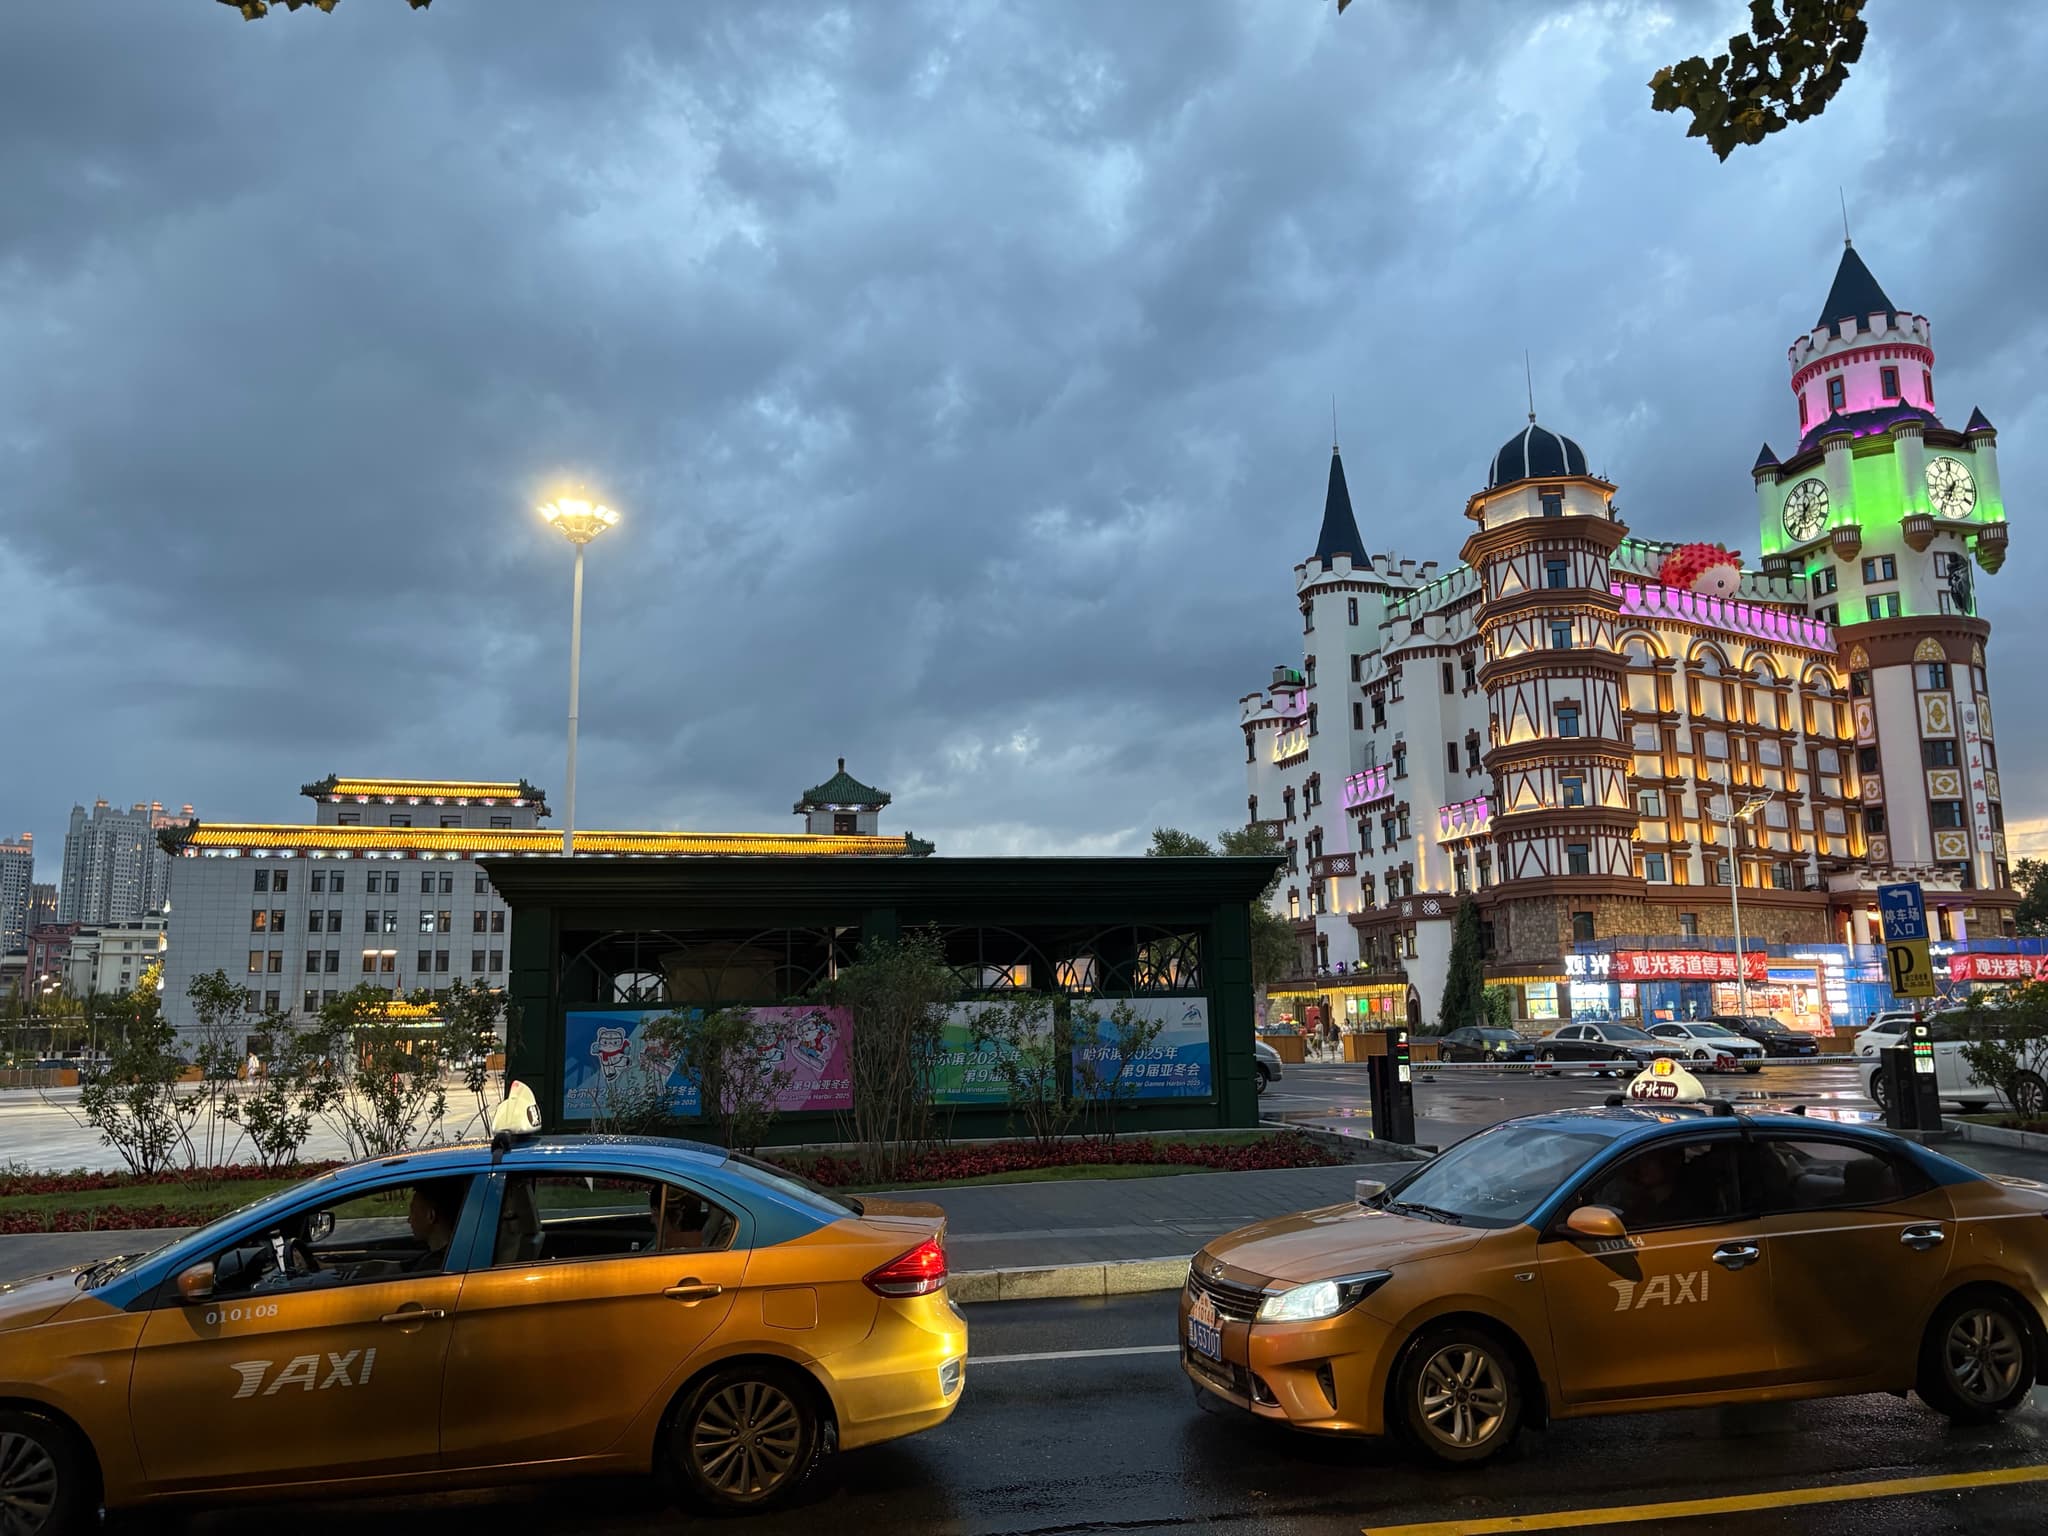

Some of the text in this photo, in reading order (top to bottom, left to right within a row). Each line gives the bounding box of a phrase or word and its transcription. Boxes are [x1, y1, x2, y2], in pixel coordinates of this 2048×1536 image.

[1884, 907, 1920, 924] 停车场
[1893, 922, 1915, 936] 入口
[1631, 954, 1752, 977] 观光索道售票处
[1889, 946, 1914, 993] P
[1975, 958, 2042, 977] 观光索道
[1121, 1062, 1201, 1078] 第9届亚冬会
[1634, 1081, 1675, 1097] 中北 TAXI
[1596, 1236, 1646, 1253] 110144
[1607, 1270, 1710, 1312] TAXI
[205, 1304, 279, 1325] 010108
[230, 1347, 377, 1400] TAXI
